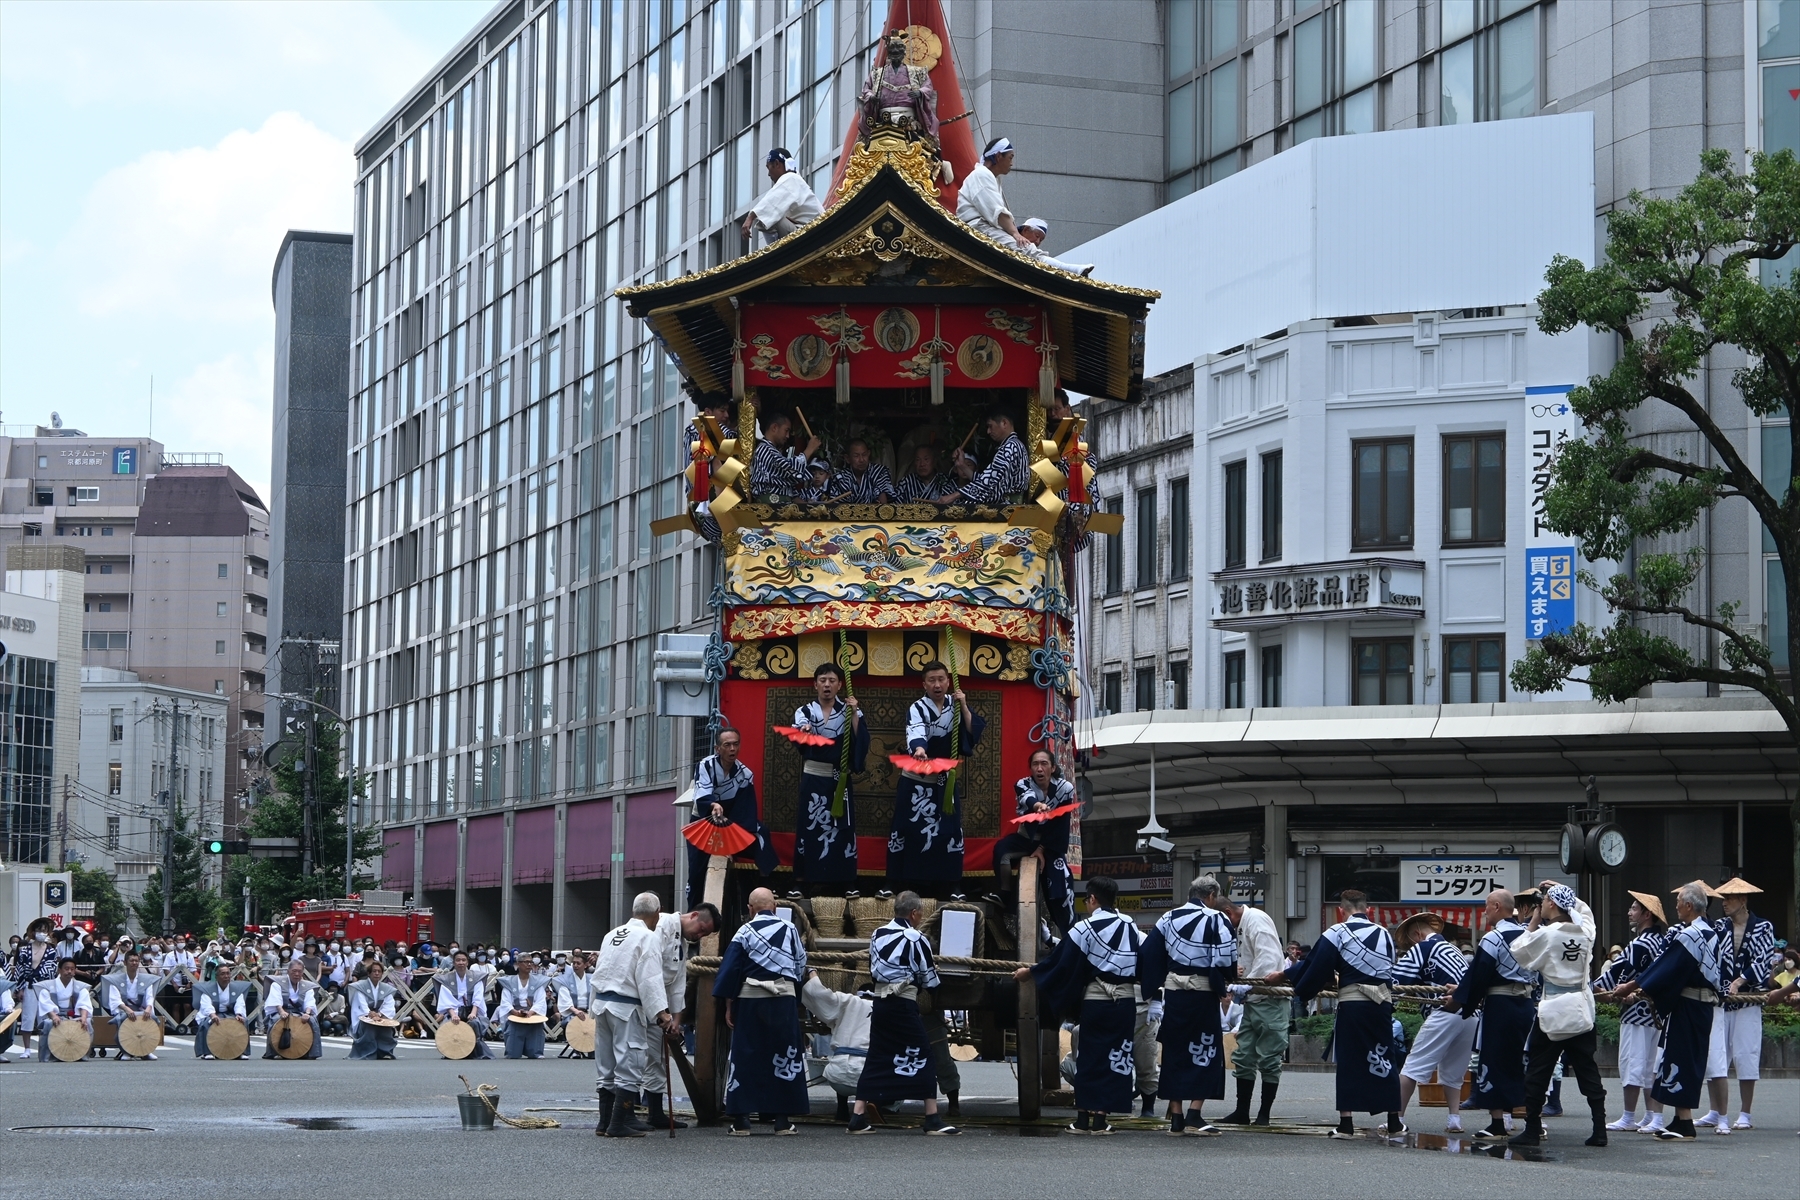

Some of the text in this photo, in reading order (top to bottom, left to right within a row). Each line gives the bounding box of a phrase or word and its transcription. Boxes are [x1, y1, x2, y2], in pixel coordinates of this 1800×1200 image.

[67, 458, 103, 466] 京都河原町
[1551, 557, 1569, 598] すぐ
[1219, 573, 1370, 614] 池善化粧品店
[1530, 556, 1549, 636] 買えます
[1445, 865, 1505, 874] メガネスーパー
[1416, 878, 1505, 896] コンタクト
